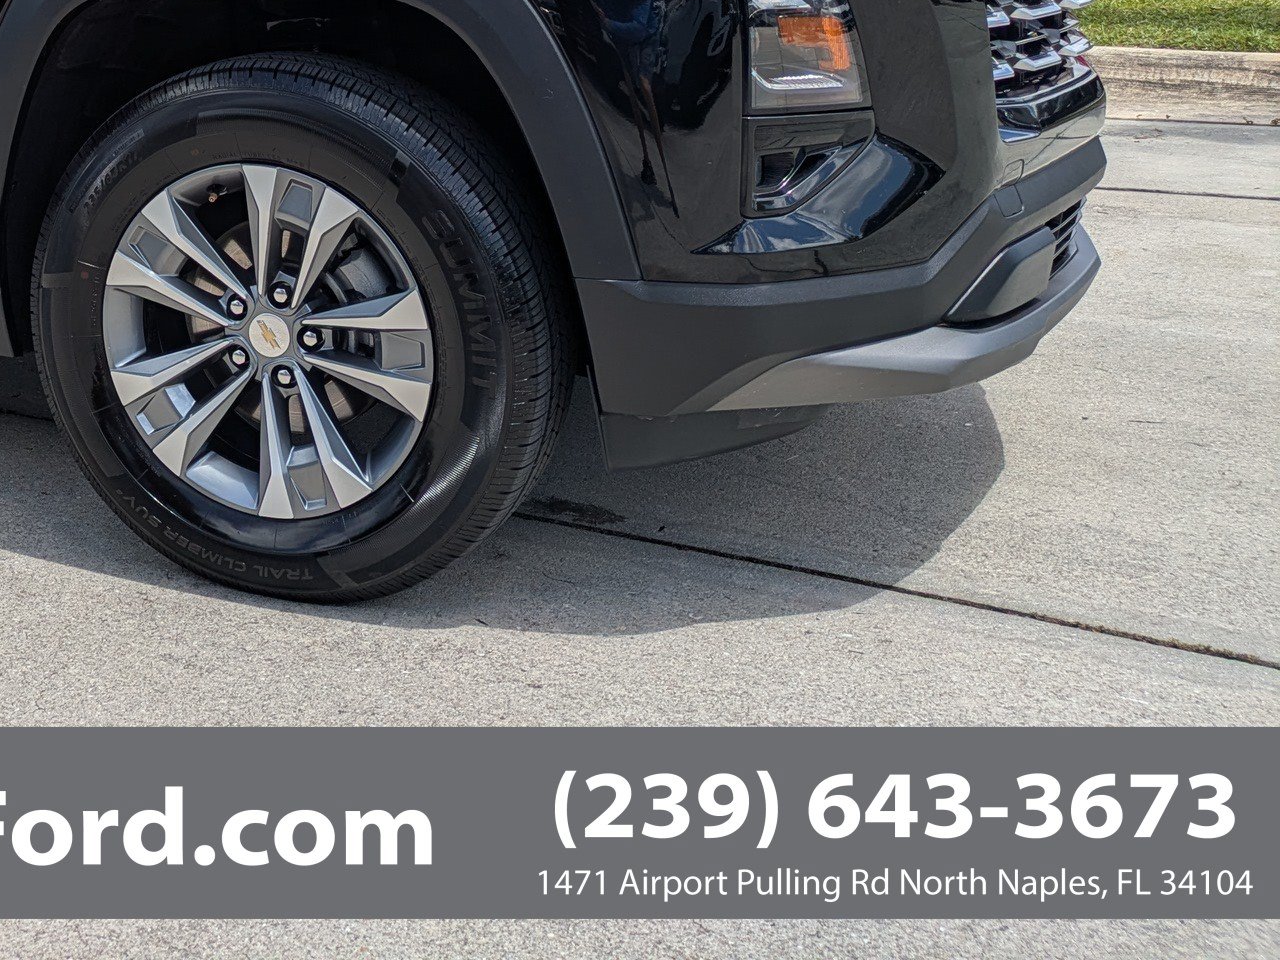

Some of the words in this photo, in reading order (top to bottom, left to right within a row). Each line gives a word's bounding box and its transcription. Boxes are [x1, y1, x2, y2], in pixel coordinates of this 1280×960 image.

[122, 495, 162, 528] SUV
[165, 526, 248, 572] CLIMBER
[253, 565, 313, 580] TRAIL
